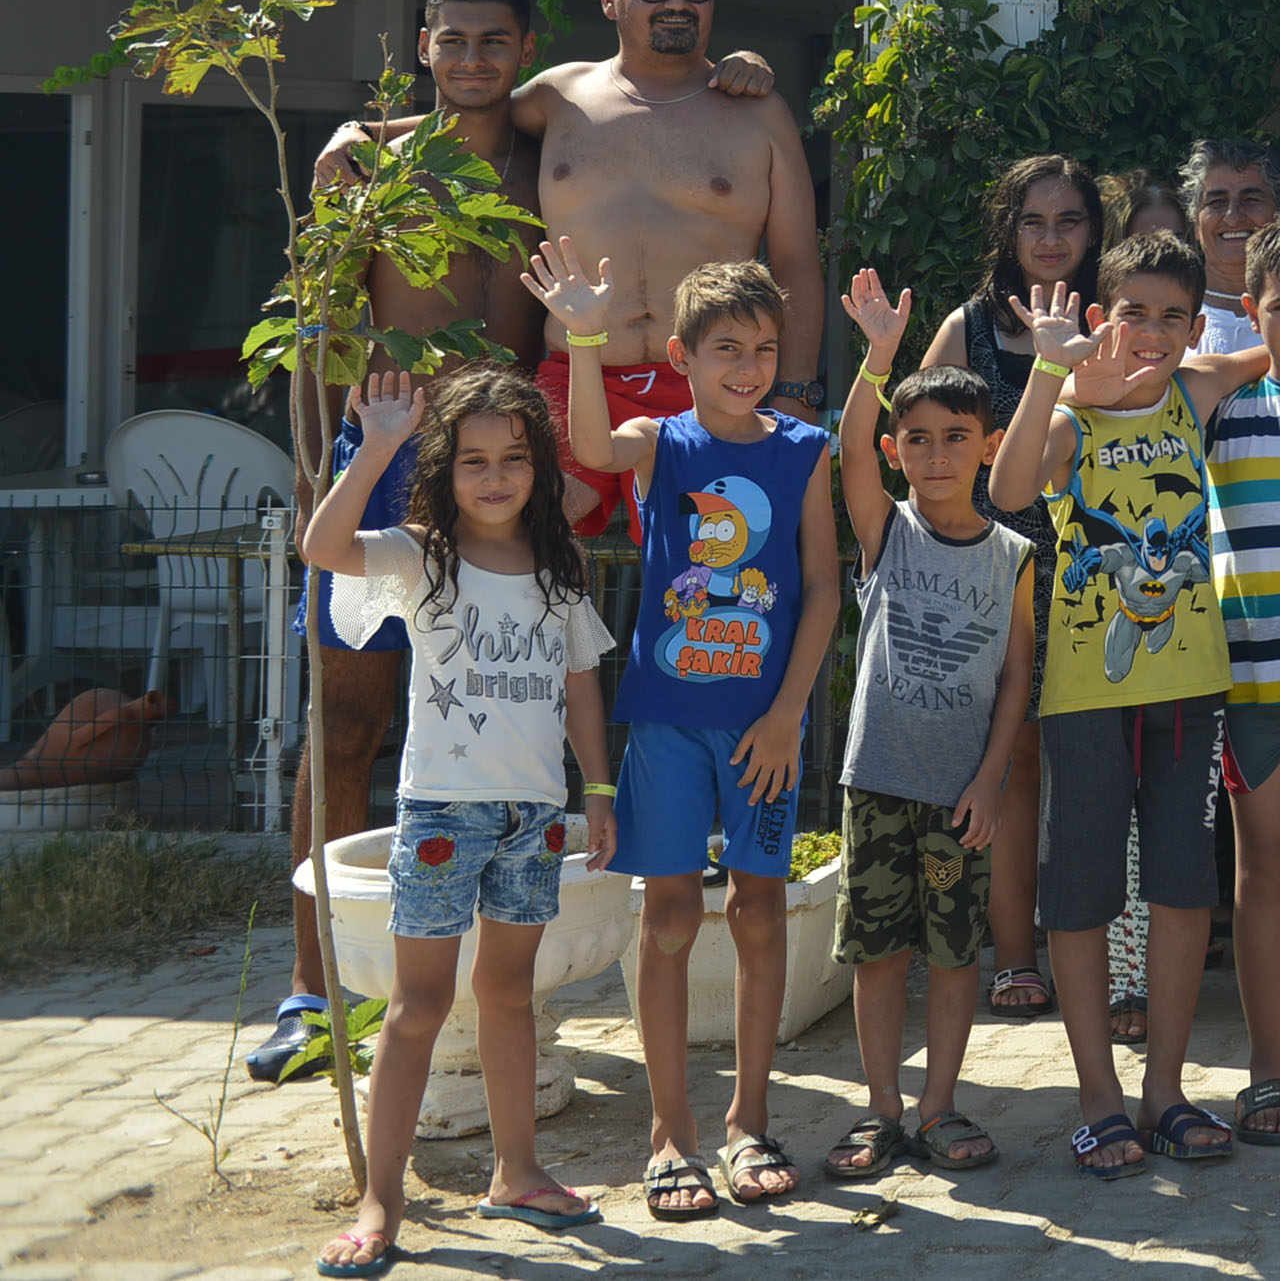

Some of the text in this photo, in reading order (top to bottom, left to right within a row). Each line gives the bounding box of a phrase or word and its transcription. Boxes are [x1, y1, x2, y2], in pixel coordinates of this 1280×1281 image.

[1097, 437, 1189, 466] BATMAN
[427, 603, 564, 666] Shine
[685, 616, 762, 646] KRAL
[675, 643, 763, 678] ŞAKİR
[465, 668, 553, 703] bright
[875, 671, 974, 711] JEANS
